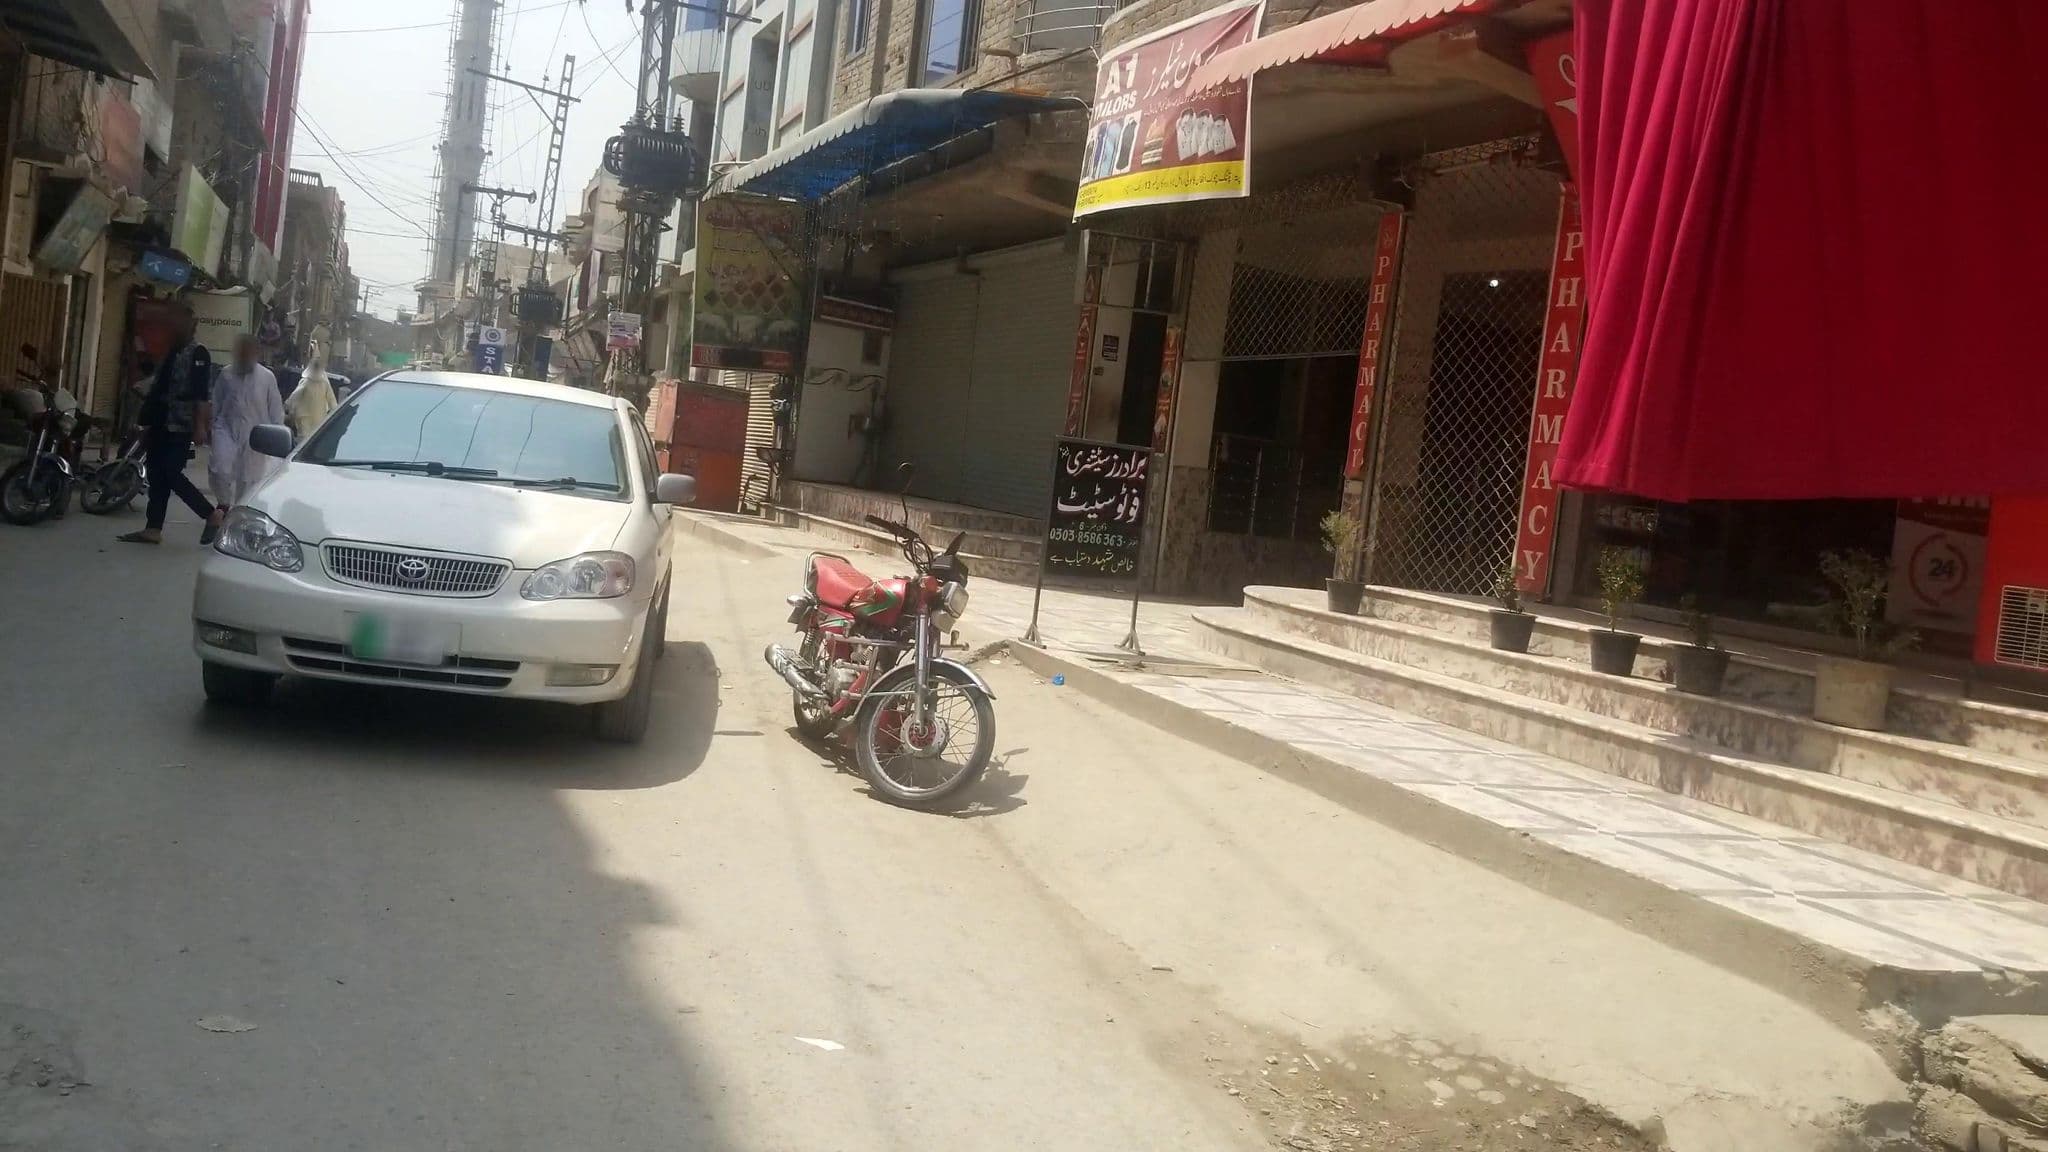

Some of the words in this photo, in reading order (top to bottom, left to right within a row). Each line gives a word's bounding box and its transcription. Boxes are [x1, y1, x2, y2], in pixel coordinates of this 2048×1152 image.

[1101, 53, 1139, 99] A1
[1351, 255, 1391, 468] PHARMACY
[1522, 231, 1585, 581] PHARMACY
[1104, 451, 1148, 480] برادرز
[1112, 482, 1140, 524] فوٹو
